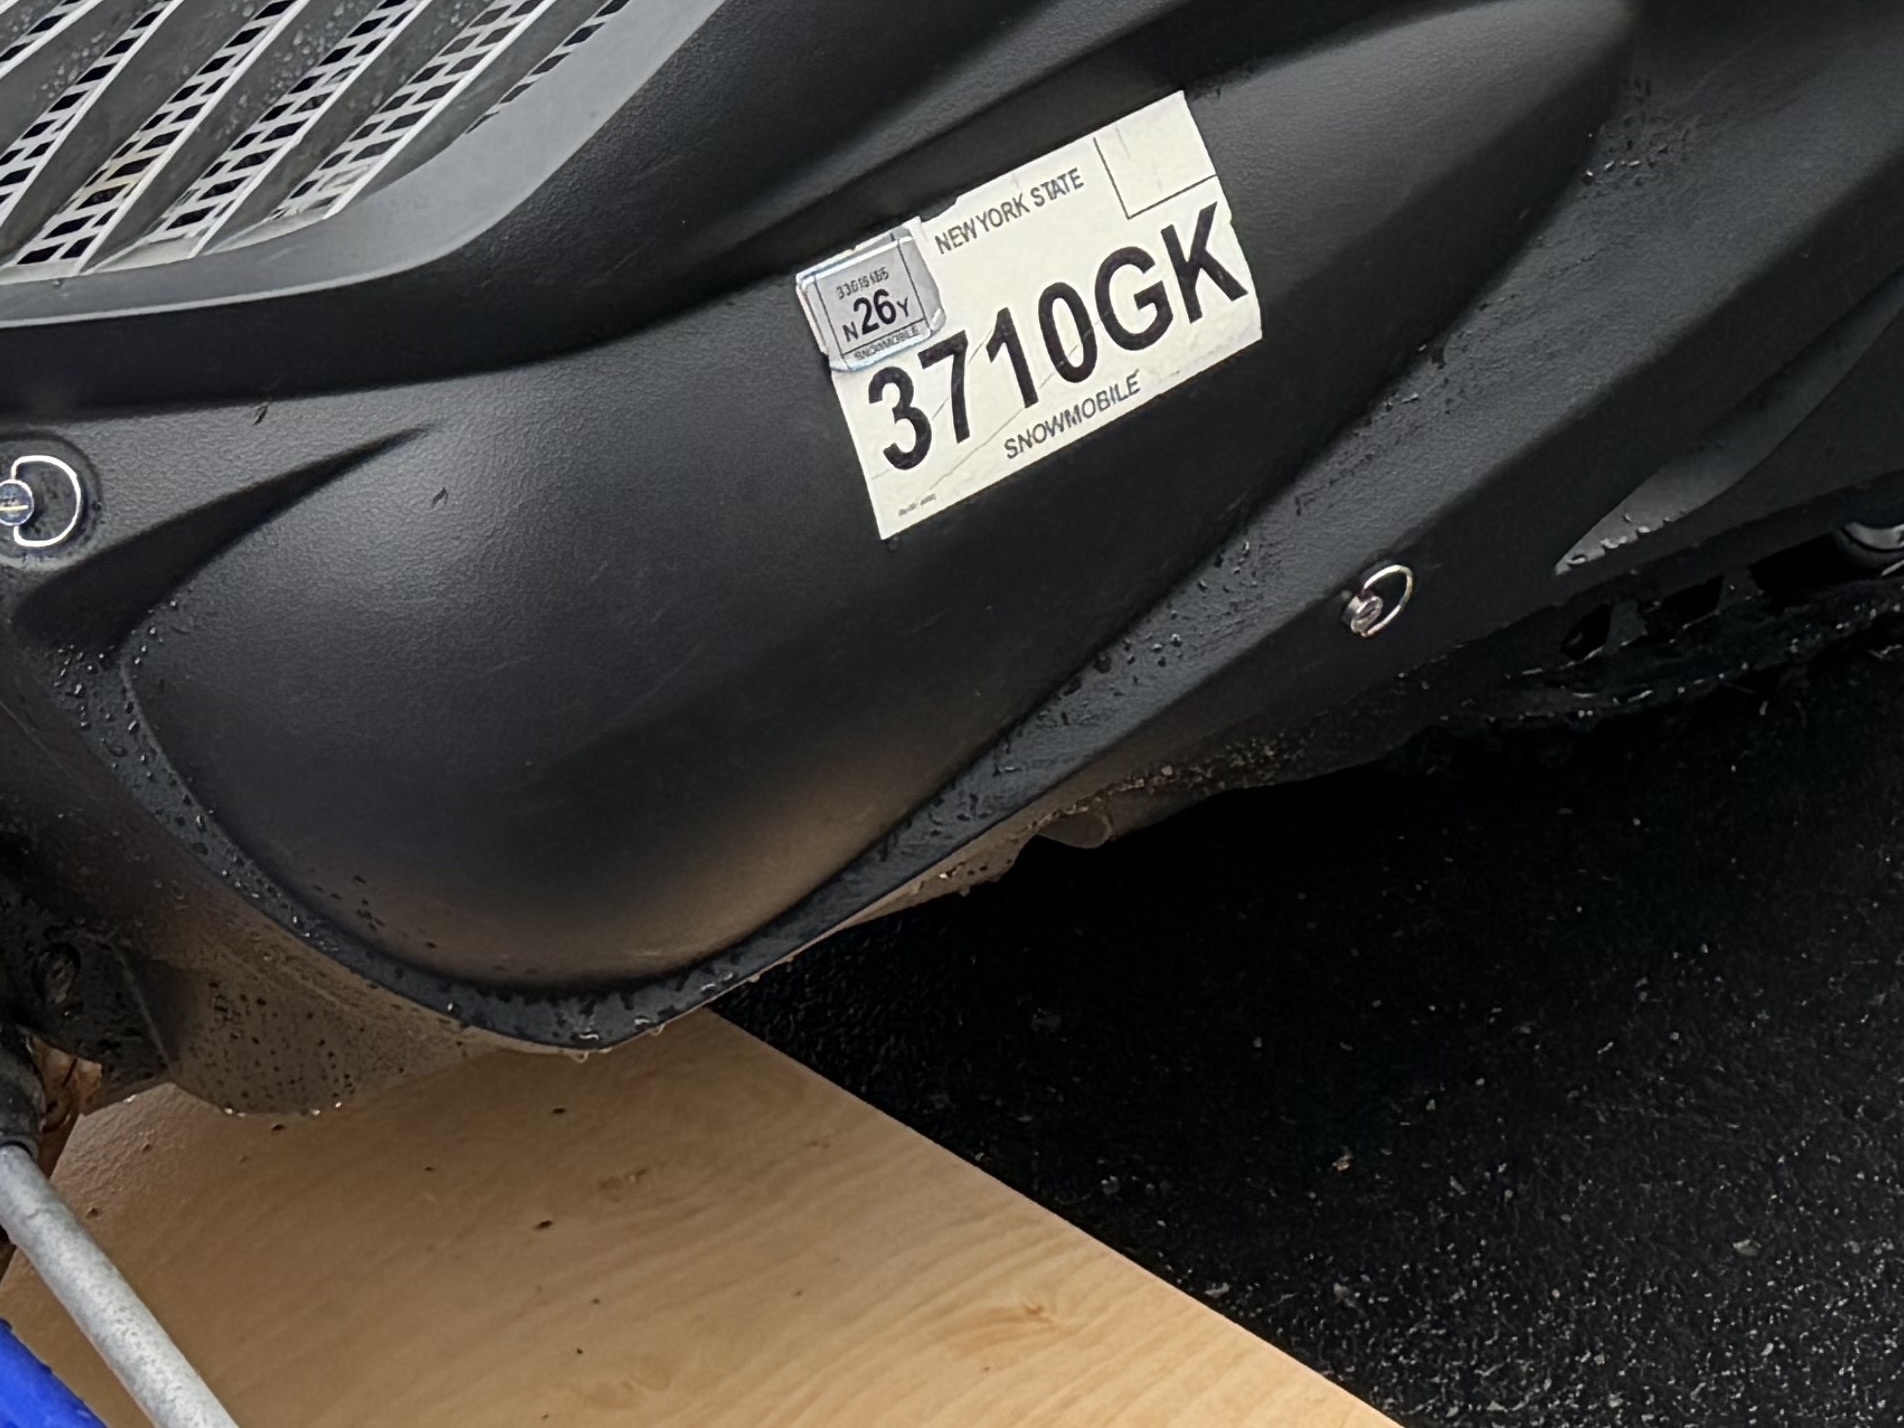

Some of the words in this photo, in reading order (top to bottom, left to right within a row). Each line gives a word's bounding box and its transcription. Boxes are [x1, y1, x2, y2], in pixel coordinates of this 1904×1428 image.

[934, 218, 978, 255] NEW
[976, 193, 1031, 232] YORK
[1030, 167, 1084, 207] STATE
[854, 326, 920, 360] SNOWMOBILE
[867, 201, 1249, 471] 3710GK
[1004, 368, 1141, 460] SNOWMOBILE
